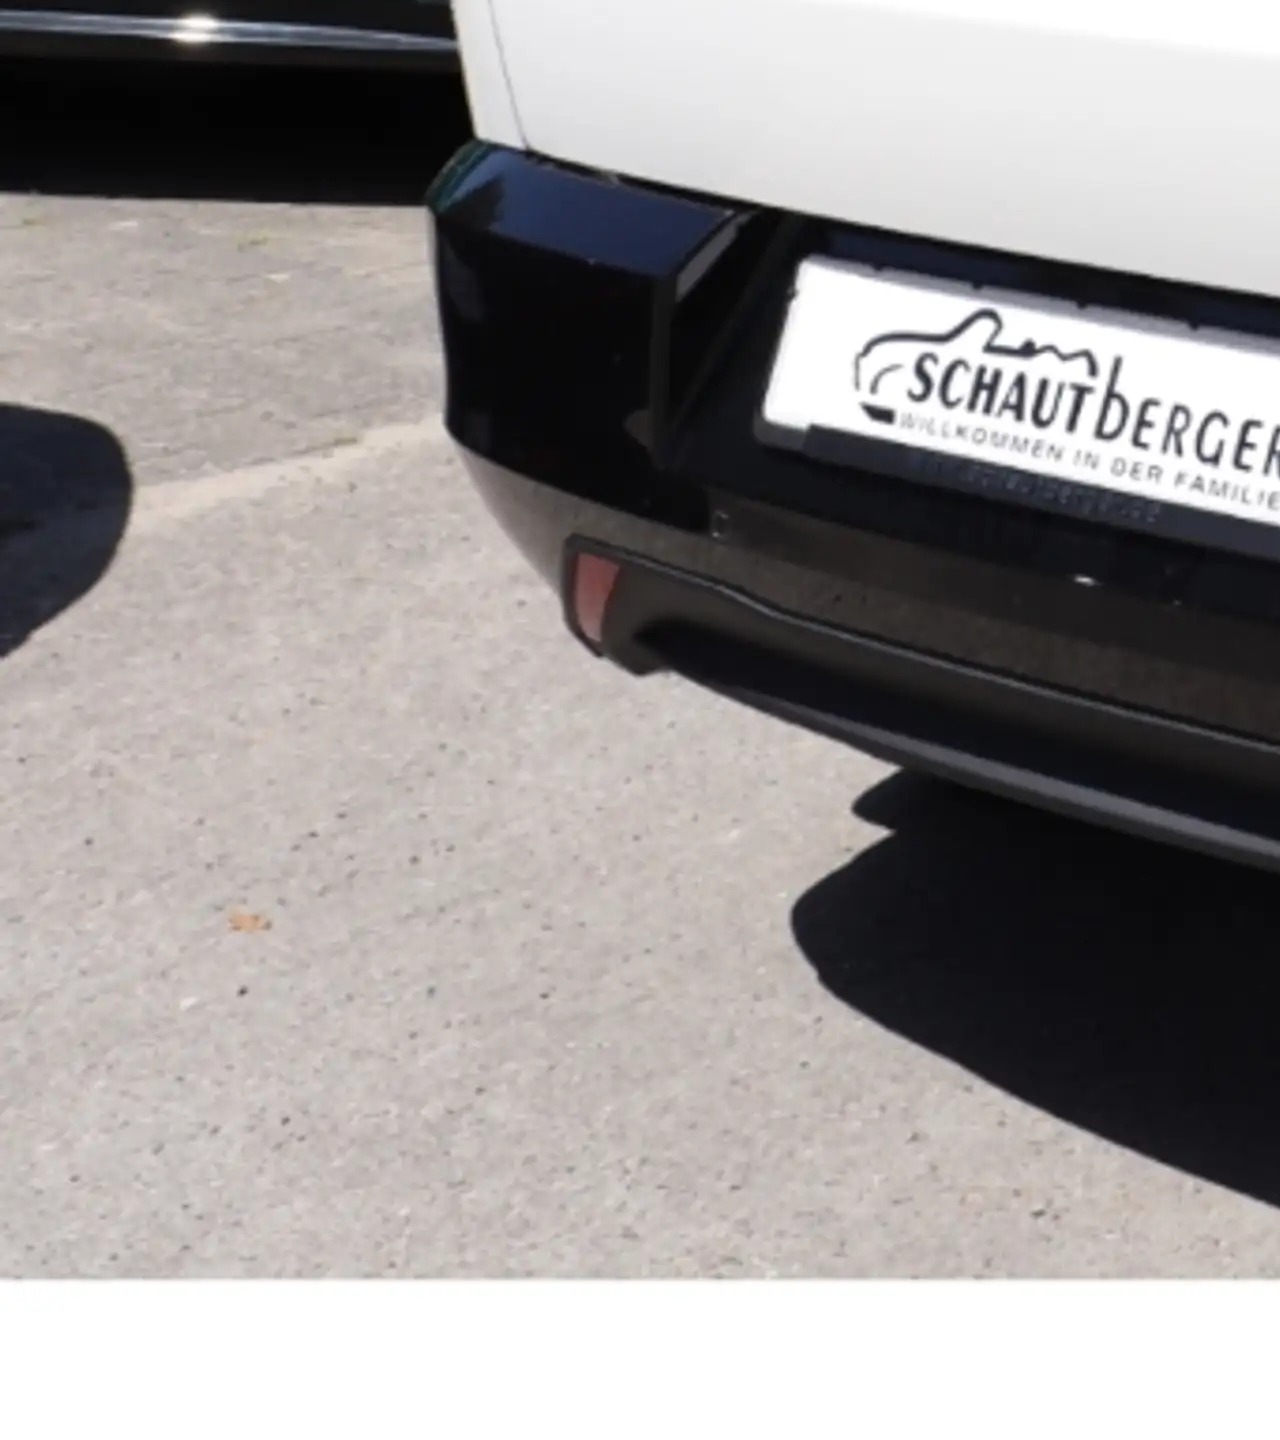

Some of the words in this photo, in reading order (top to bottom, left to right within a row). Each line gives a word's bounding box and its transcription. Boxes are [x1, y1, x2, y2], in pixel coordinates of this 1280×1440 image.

[900, 412, 1064, 462] WILLKOMMEN
[1073, 449, 1100, 471] IN
[1110, 457, 1164, 484] DER
